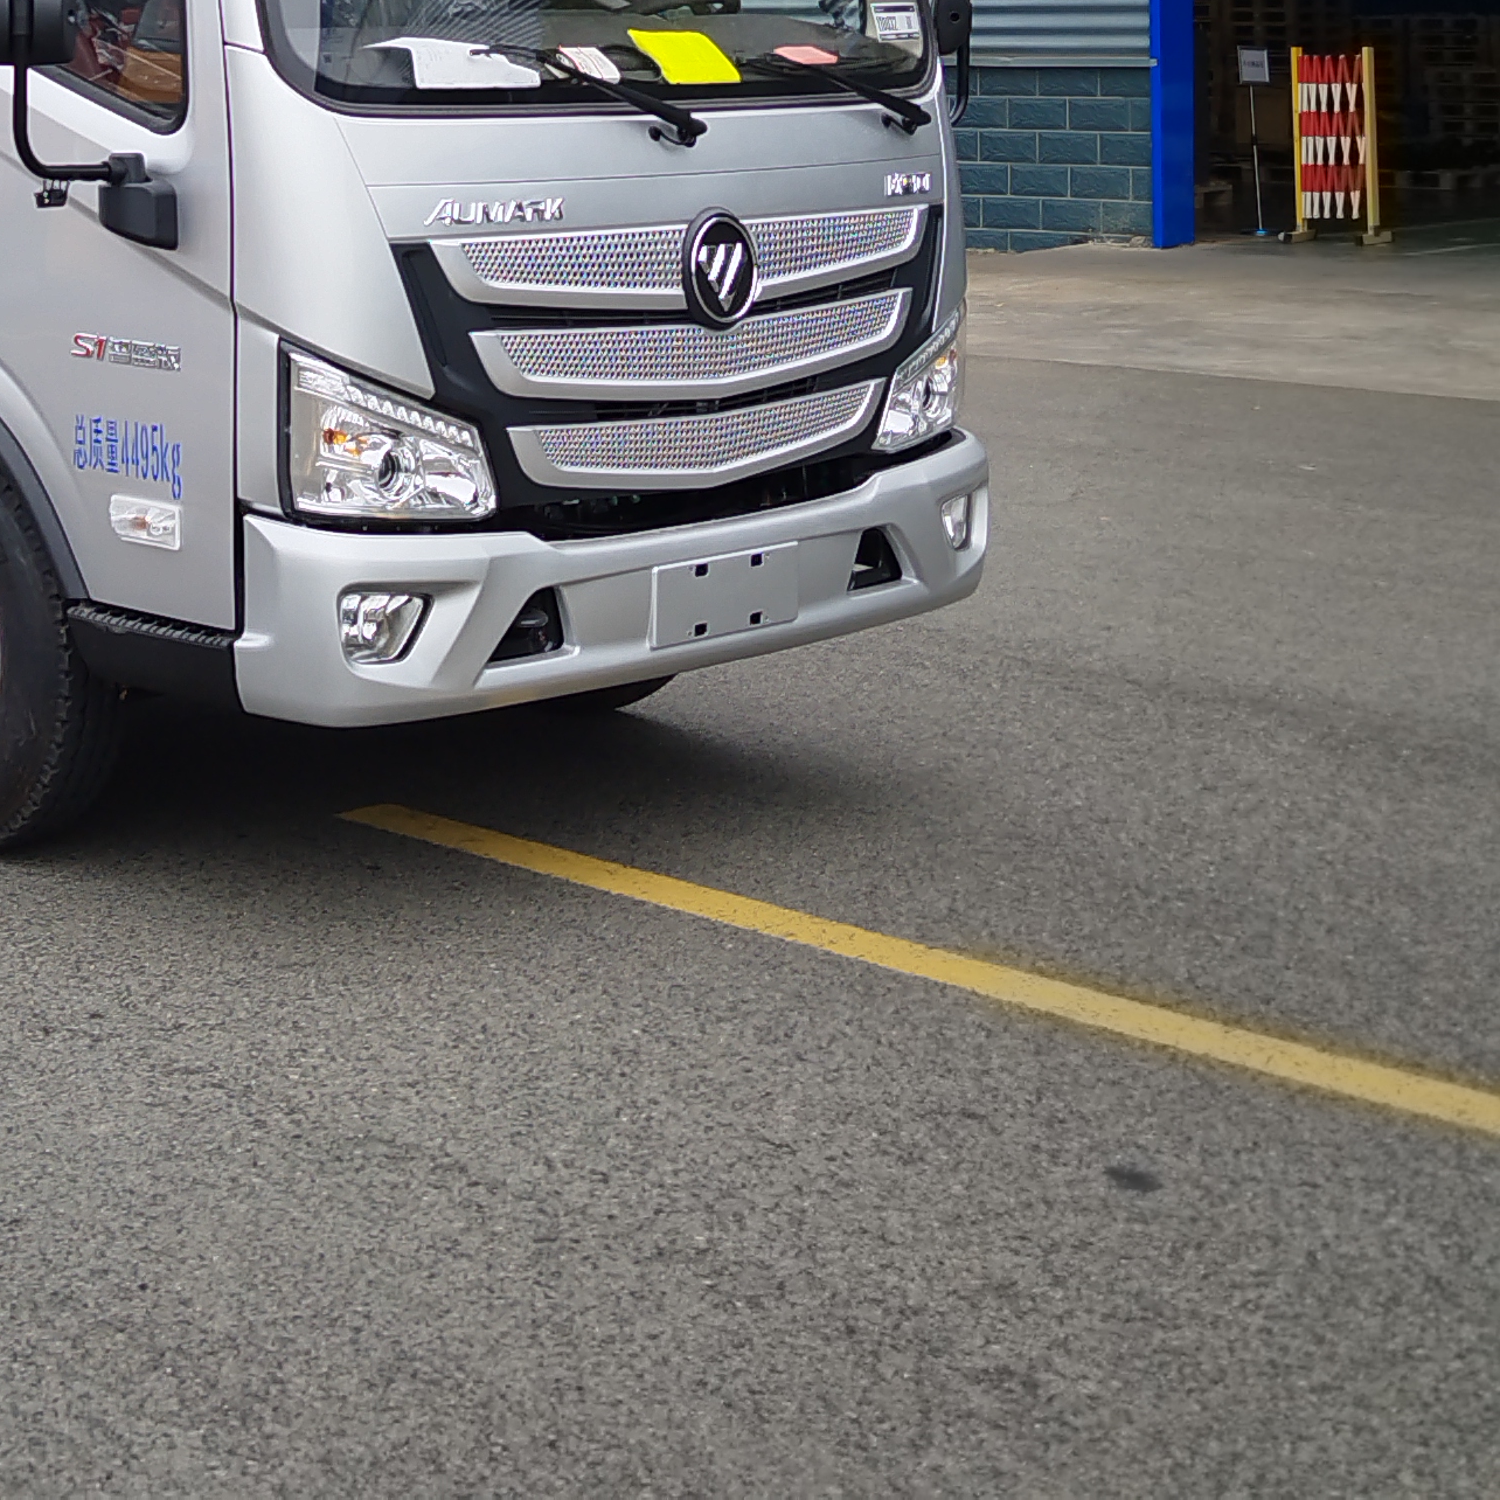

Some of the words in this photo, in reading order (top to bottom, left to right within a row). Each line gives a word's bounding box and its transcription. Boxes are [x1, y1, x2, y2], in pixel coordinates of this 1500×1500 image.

[423, 197, 564, 226] AUMARK
[70, 332, 107, 362] S1
[73, 414, 182, 500] 总质量4495kg
